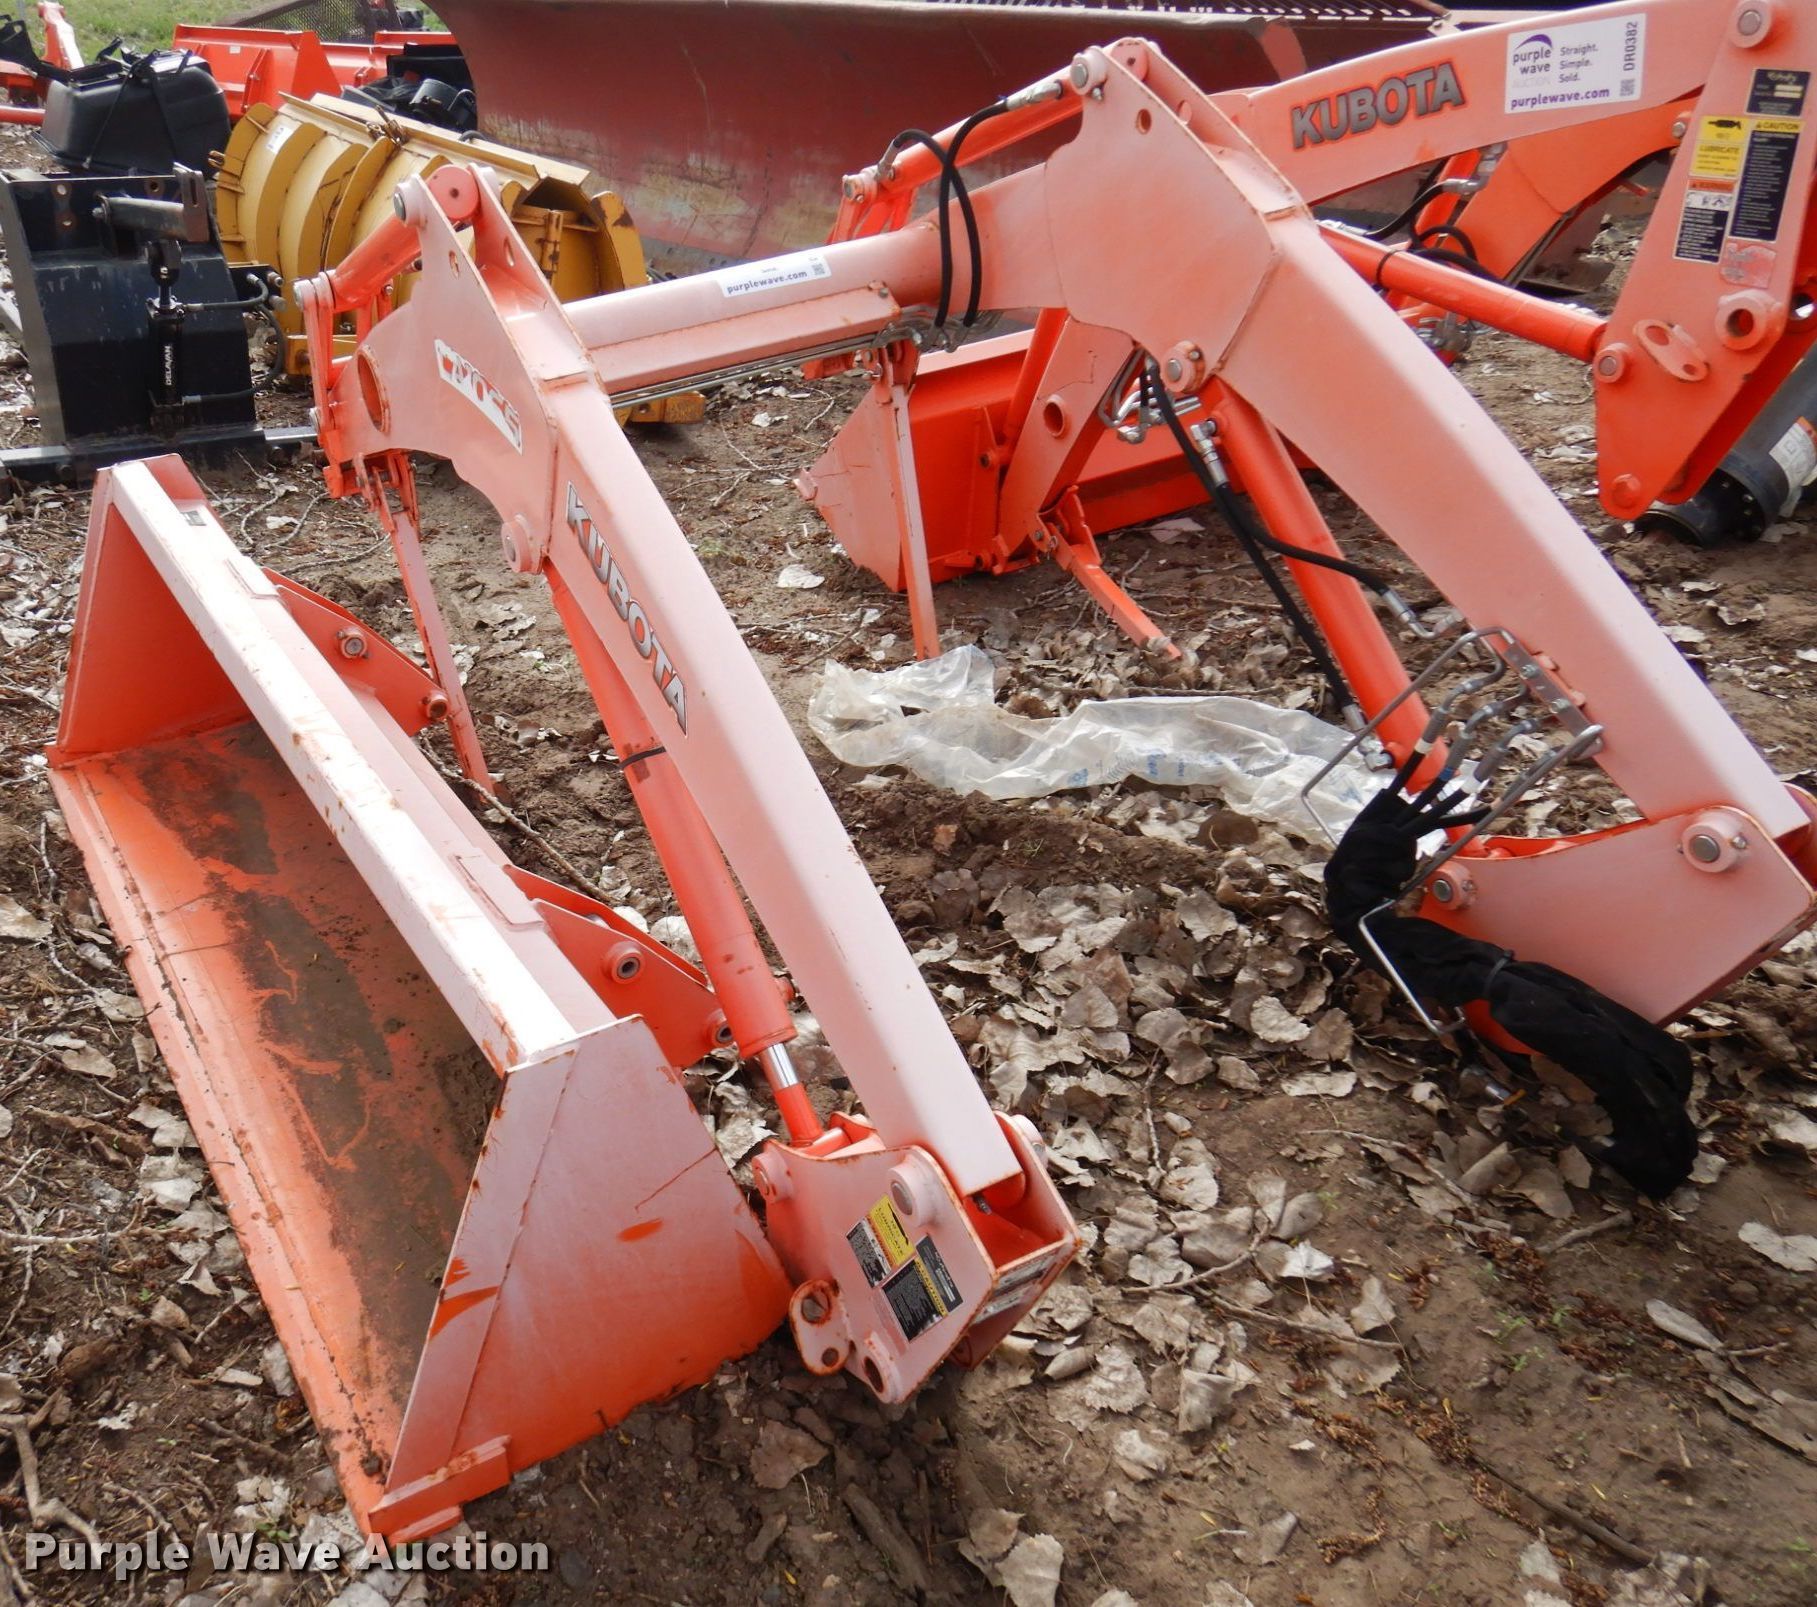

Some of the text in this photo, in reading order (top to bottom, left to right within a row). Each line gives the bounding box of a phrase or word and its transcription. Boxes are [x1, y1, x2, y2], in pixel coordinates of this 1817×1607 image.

[1512, 47, 1552, 66] purple
[1560, 43, 1599, 57] Straight.
[1623, 21, 1638, 72] DR0382
[1519, 62, 1551, 75] wave
[1291, 61, 1466, 149] KUBOTA
[1510, 88, 1610, 110] purplewave.com
[726, 270, 808, 294] purplewave.com
[566, 480, 687, 738] KUBOTA
